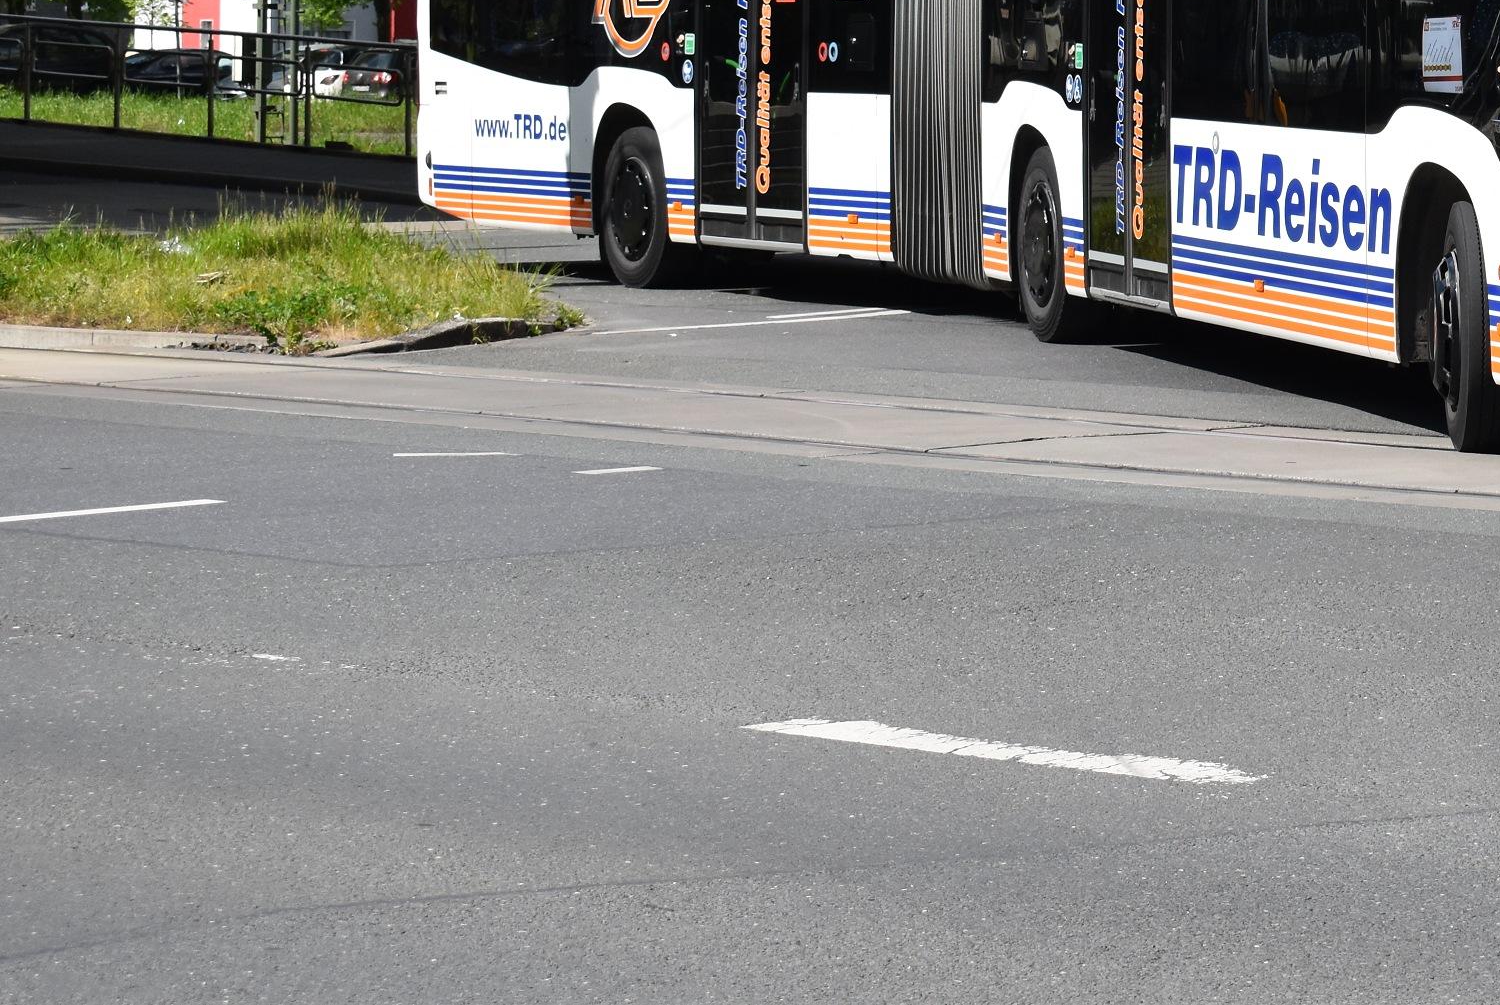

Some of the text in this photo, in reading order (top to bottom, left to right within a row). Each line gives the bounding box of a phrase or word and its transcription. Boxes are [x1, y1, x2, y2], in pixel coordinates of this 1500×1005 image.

[475, 114, 566, 141] www.TRD.de
[735, 18, 748, 190] TRD-Reisen
[756, 70, 770, 194] Qualität
[1115, 26, 1126, 235] TRD-Reisen
[1132, 89, 1145, 240] Qualität
[1174, 144, 1392, 254] TRD-Reisen
